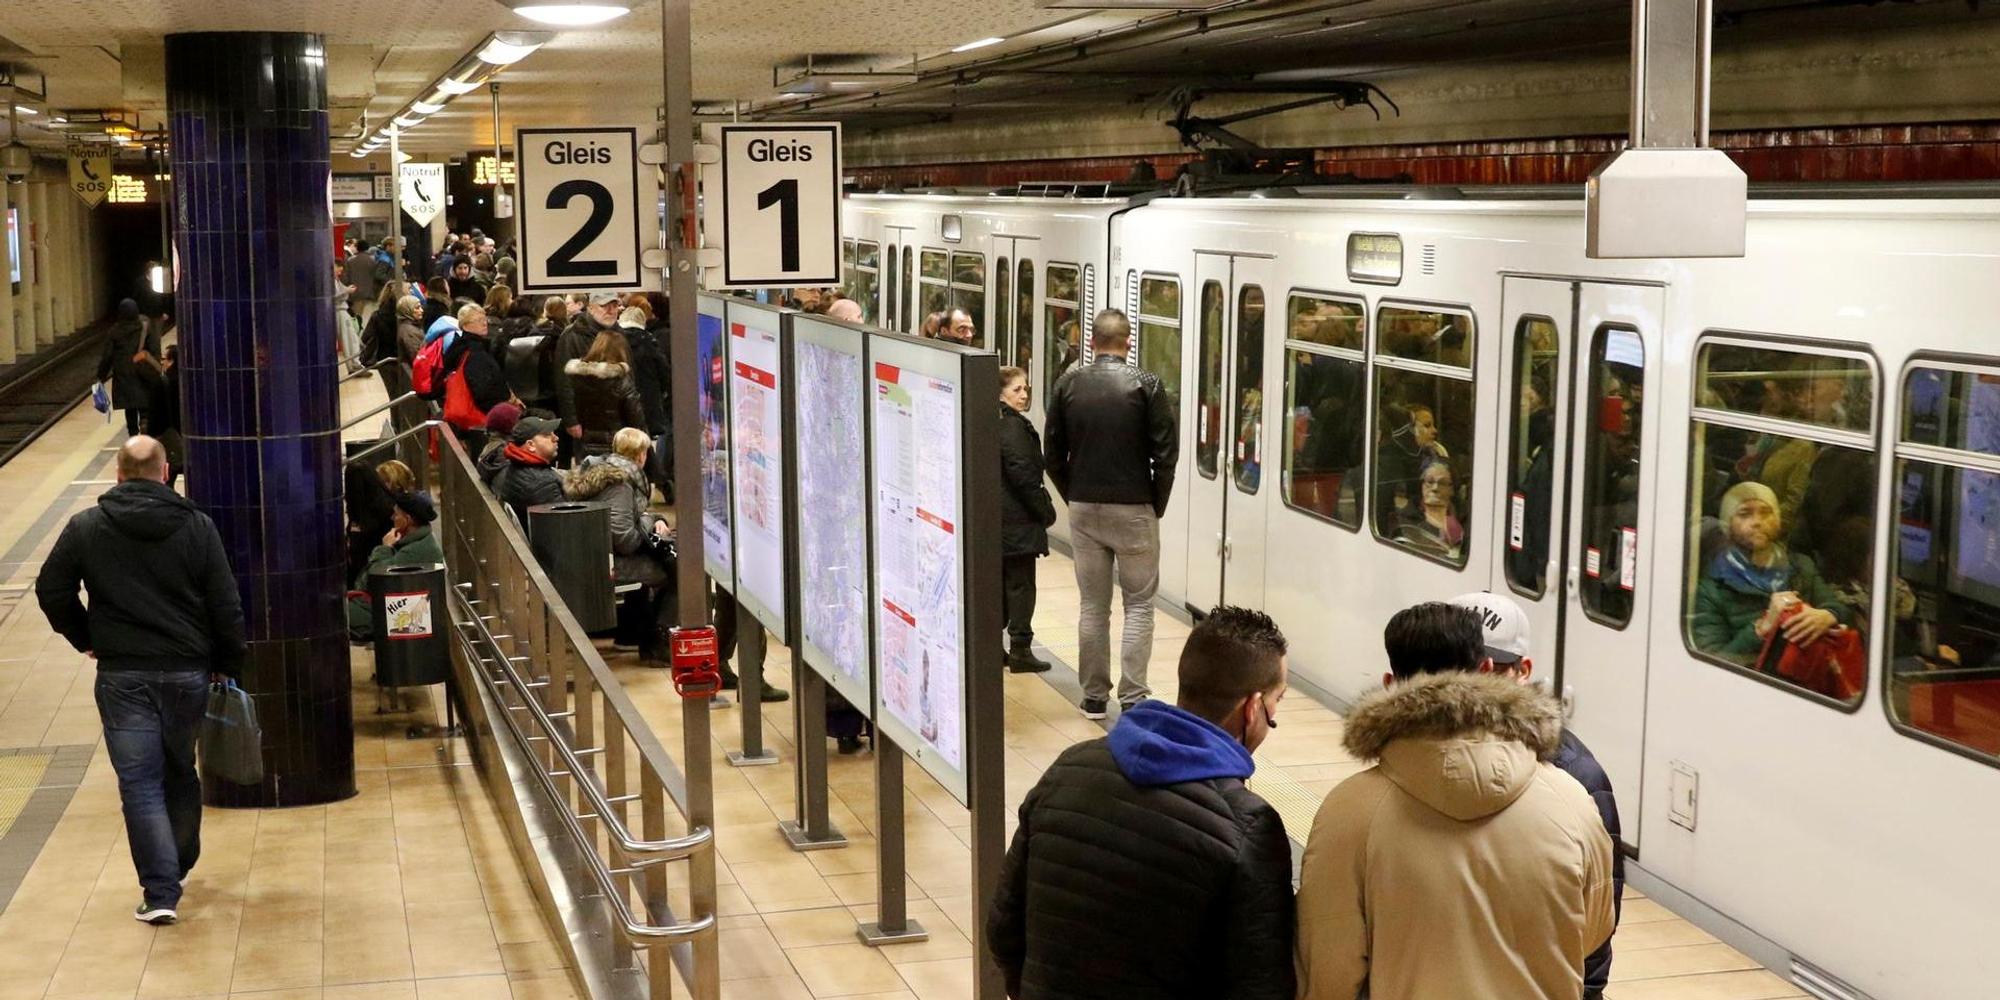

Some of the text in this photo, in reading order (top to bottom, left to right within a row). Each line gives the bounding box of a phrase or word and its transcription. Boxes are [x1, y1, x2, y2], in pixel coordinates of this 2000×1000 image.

[71, 148, 108, 158] Notruf
[544, 141, 612, 164] Gleis
[747, 139, 813, 162] Gleis
[403, 167, 442, 176] Notruf
[77, 182, 106, 192] SOS
[411, 204, 436, 213] SOS
[546, 179, 618, 277] 2
[757, 179, 800, 272] 1
[387, 597, 408, 614] Hier
